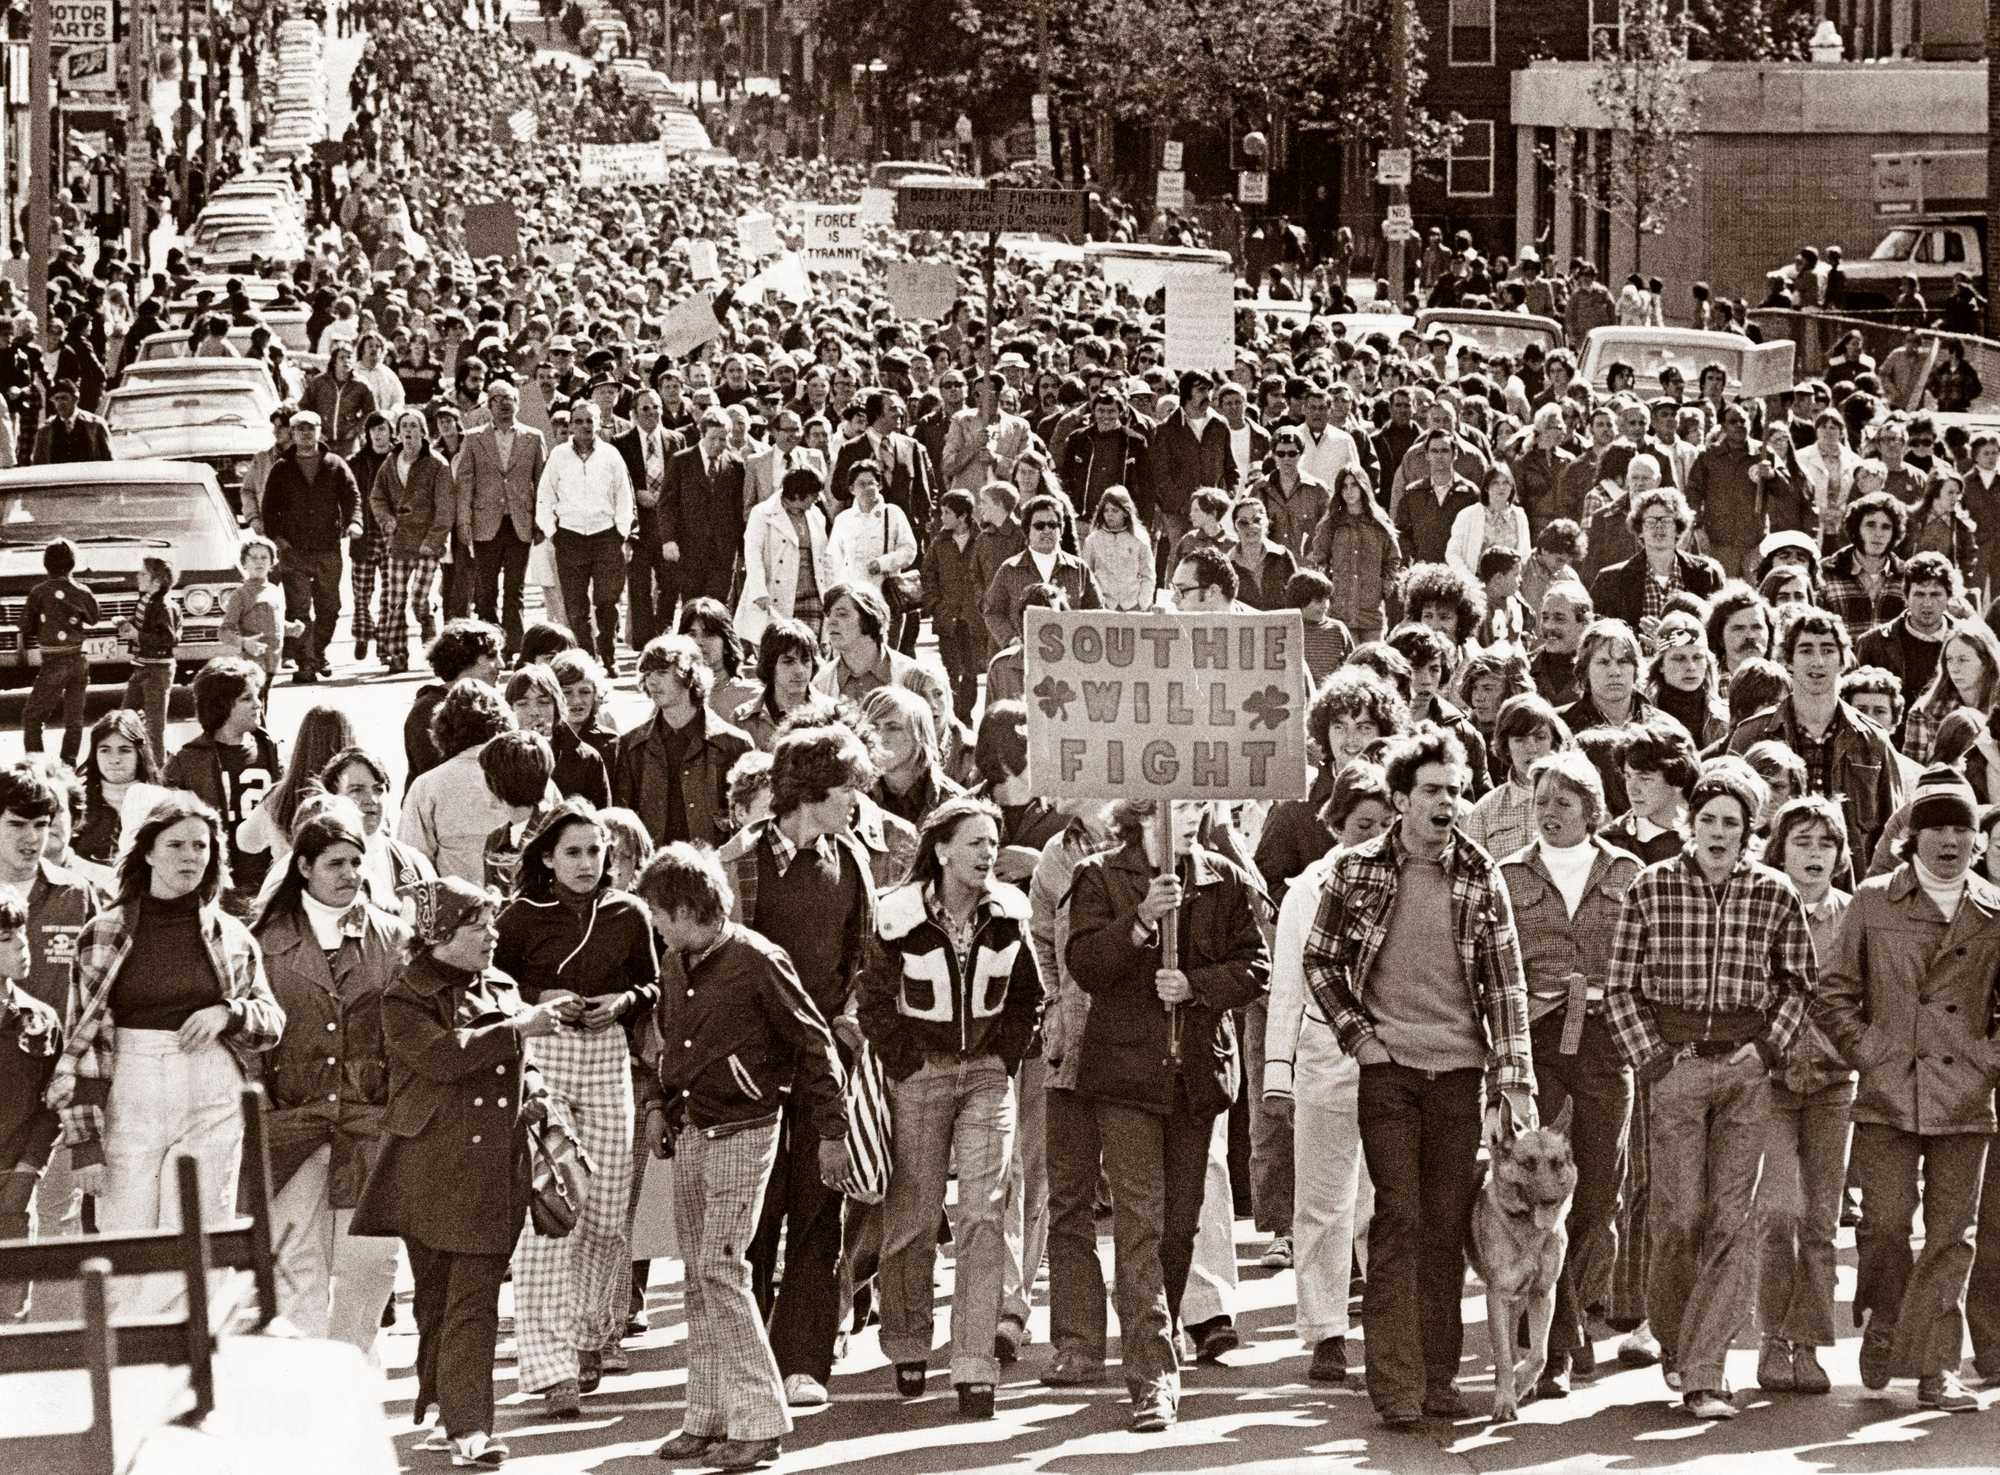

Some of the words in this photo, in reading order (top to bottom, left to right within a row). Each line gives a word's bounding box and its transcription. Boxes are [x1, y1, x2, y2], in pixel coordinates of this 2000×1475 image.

[50, 5, 106, 20] OTOR
[50, 22, 106, 37] ARTS
[1009, 191, 1076, 206] FIGHTERS
[815, 213, 857, 228] FORCE
[828, 230, 840, 243] IS
[808, 248, 861, 260] TYRANNY
[1038, 622, 1287, 670] SOUTHIE
[1081, 680, 1236, 726] WILL
[1060, 738, 1276, 787] FIGHT
